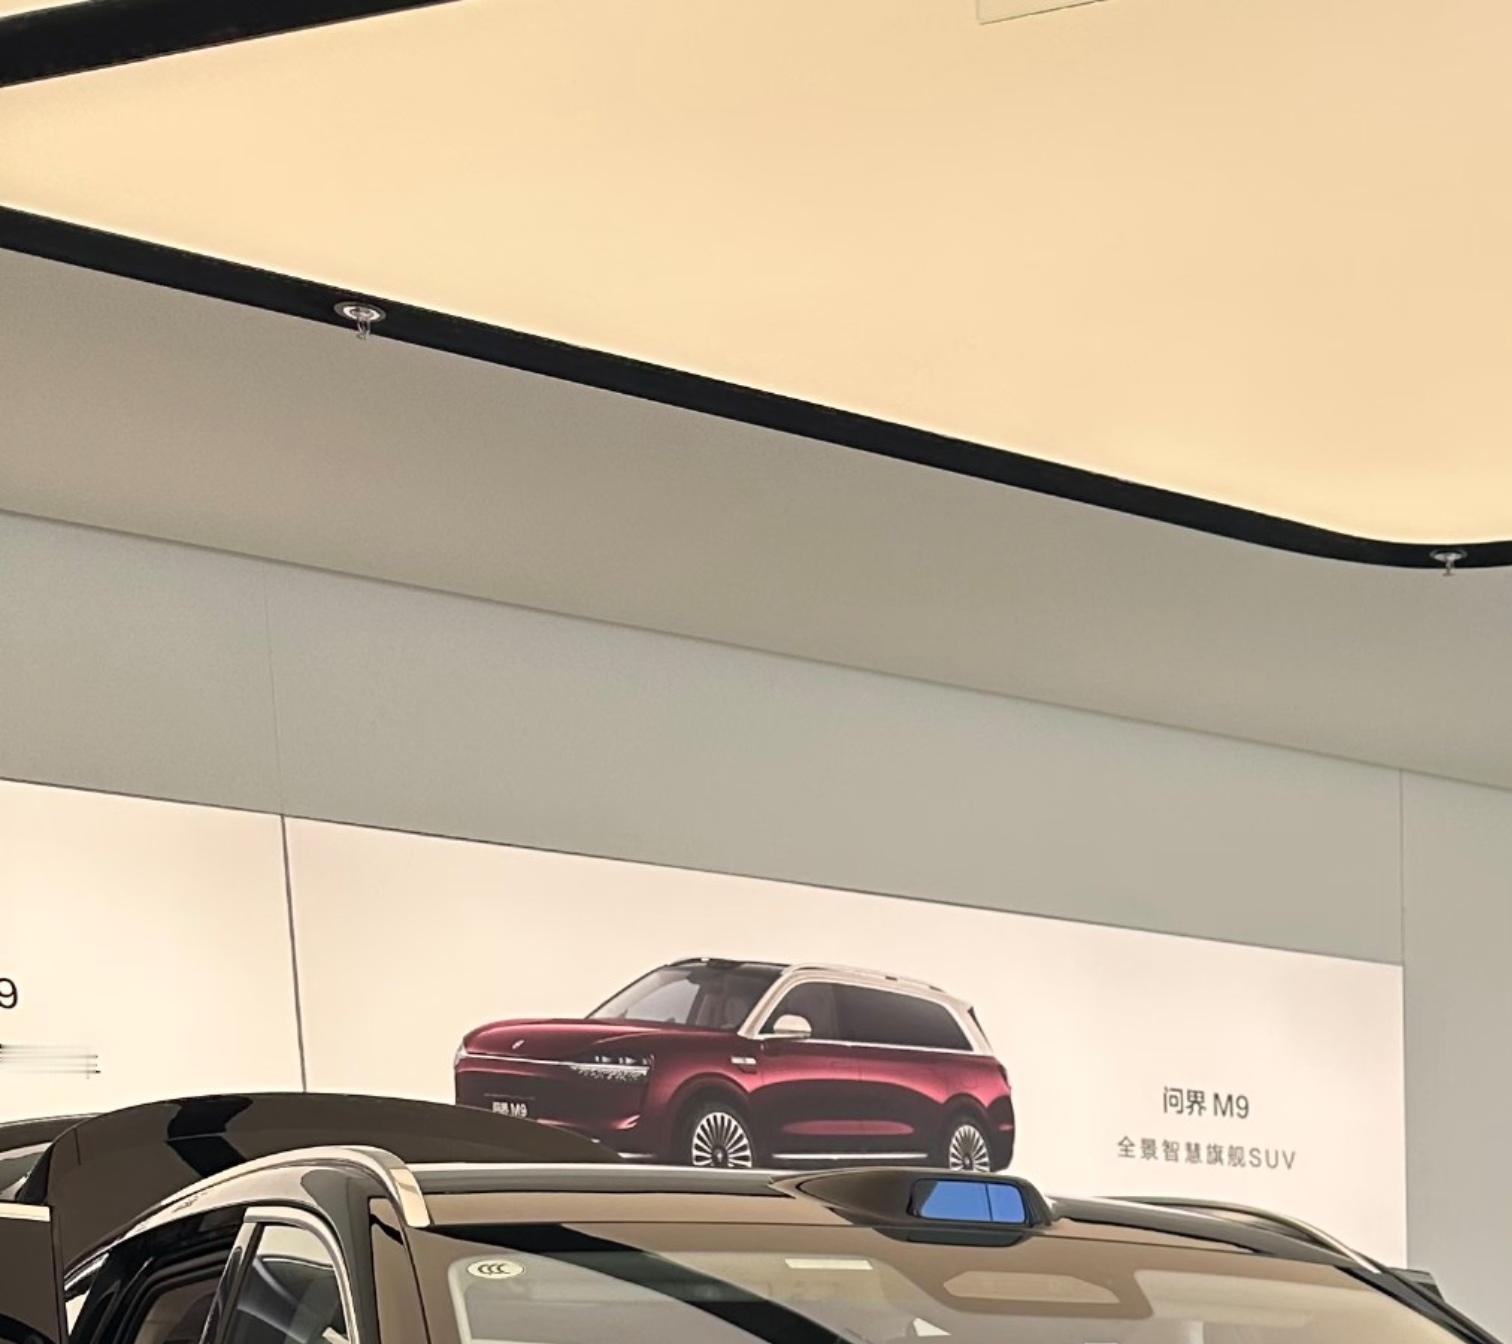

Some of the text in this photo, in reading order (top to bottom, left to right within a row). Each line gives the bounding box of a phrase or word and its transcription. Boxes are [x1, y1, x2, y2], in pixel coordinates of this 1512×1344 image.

[1162, 1086, 1249, 1119] 问界 M9
[1117, 1136, 1296, 1170] 全景智慧旗舰SUV
